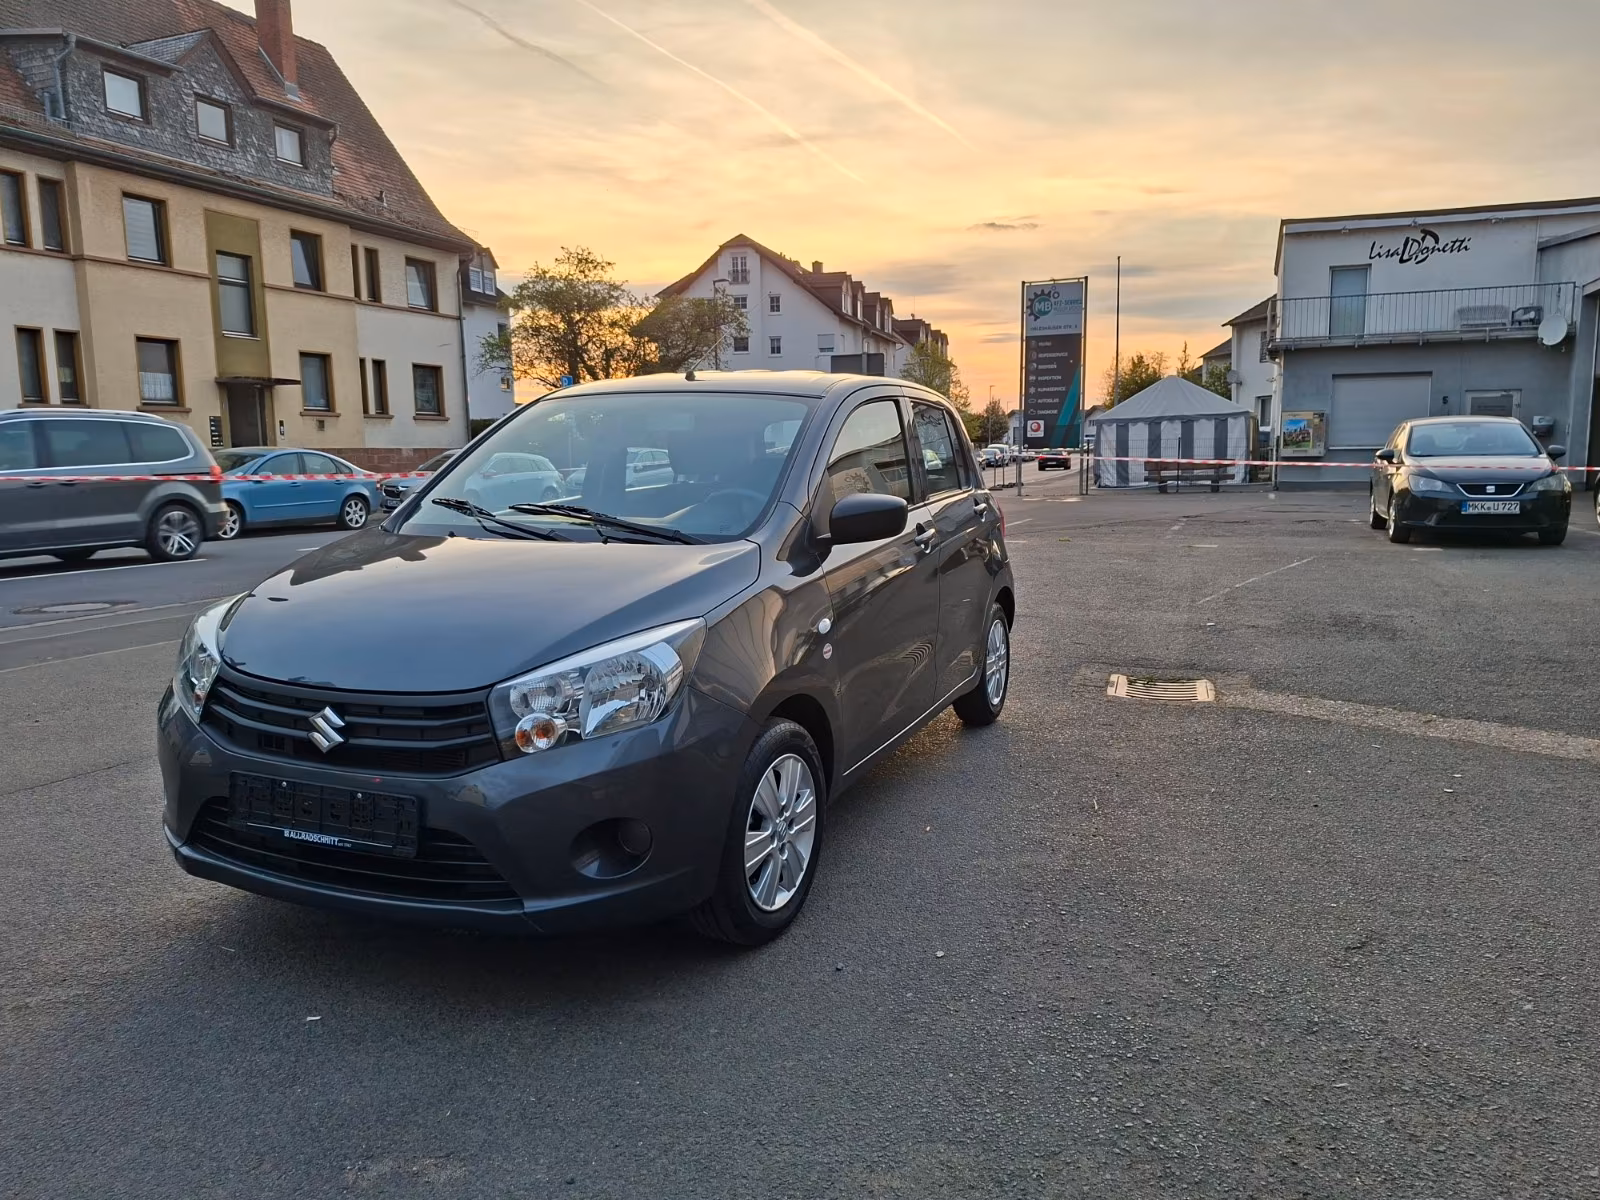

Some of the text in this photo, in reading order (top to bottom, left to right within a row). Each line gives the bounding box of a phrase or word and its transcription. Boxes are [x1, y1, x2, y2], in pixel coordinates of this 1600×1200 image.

[1035, 301, 1052, 312] MB
[1468, 502, 1518, 511] MKK U 727
